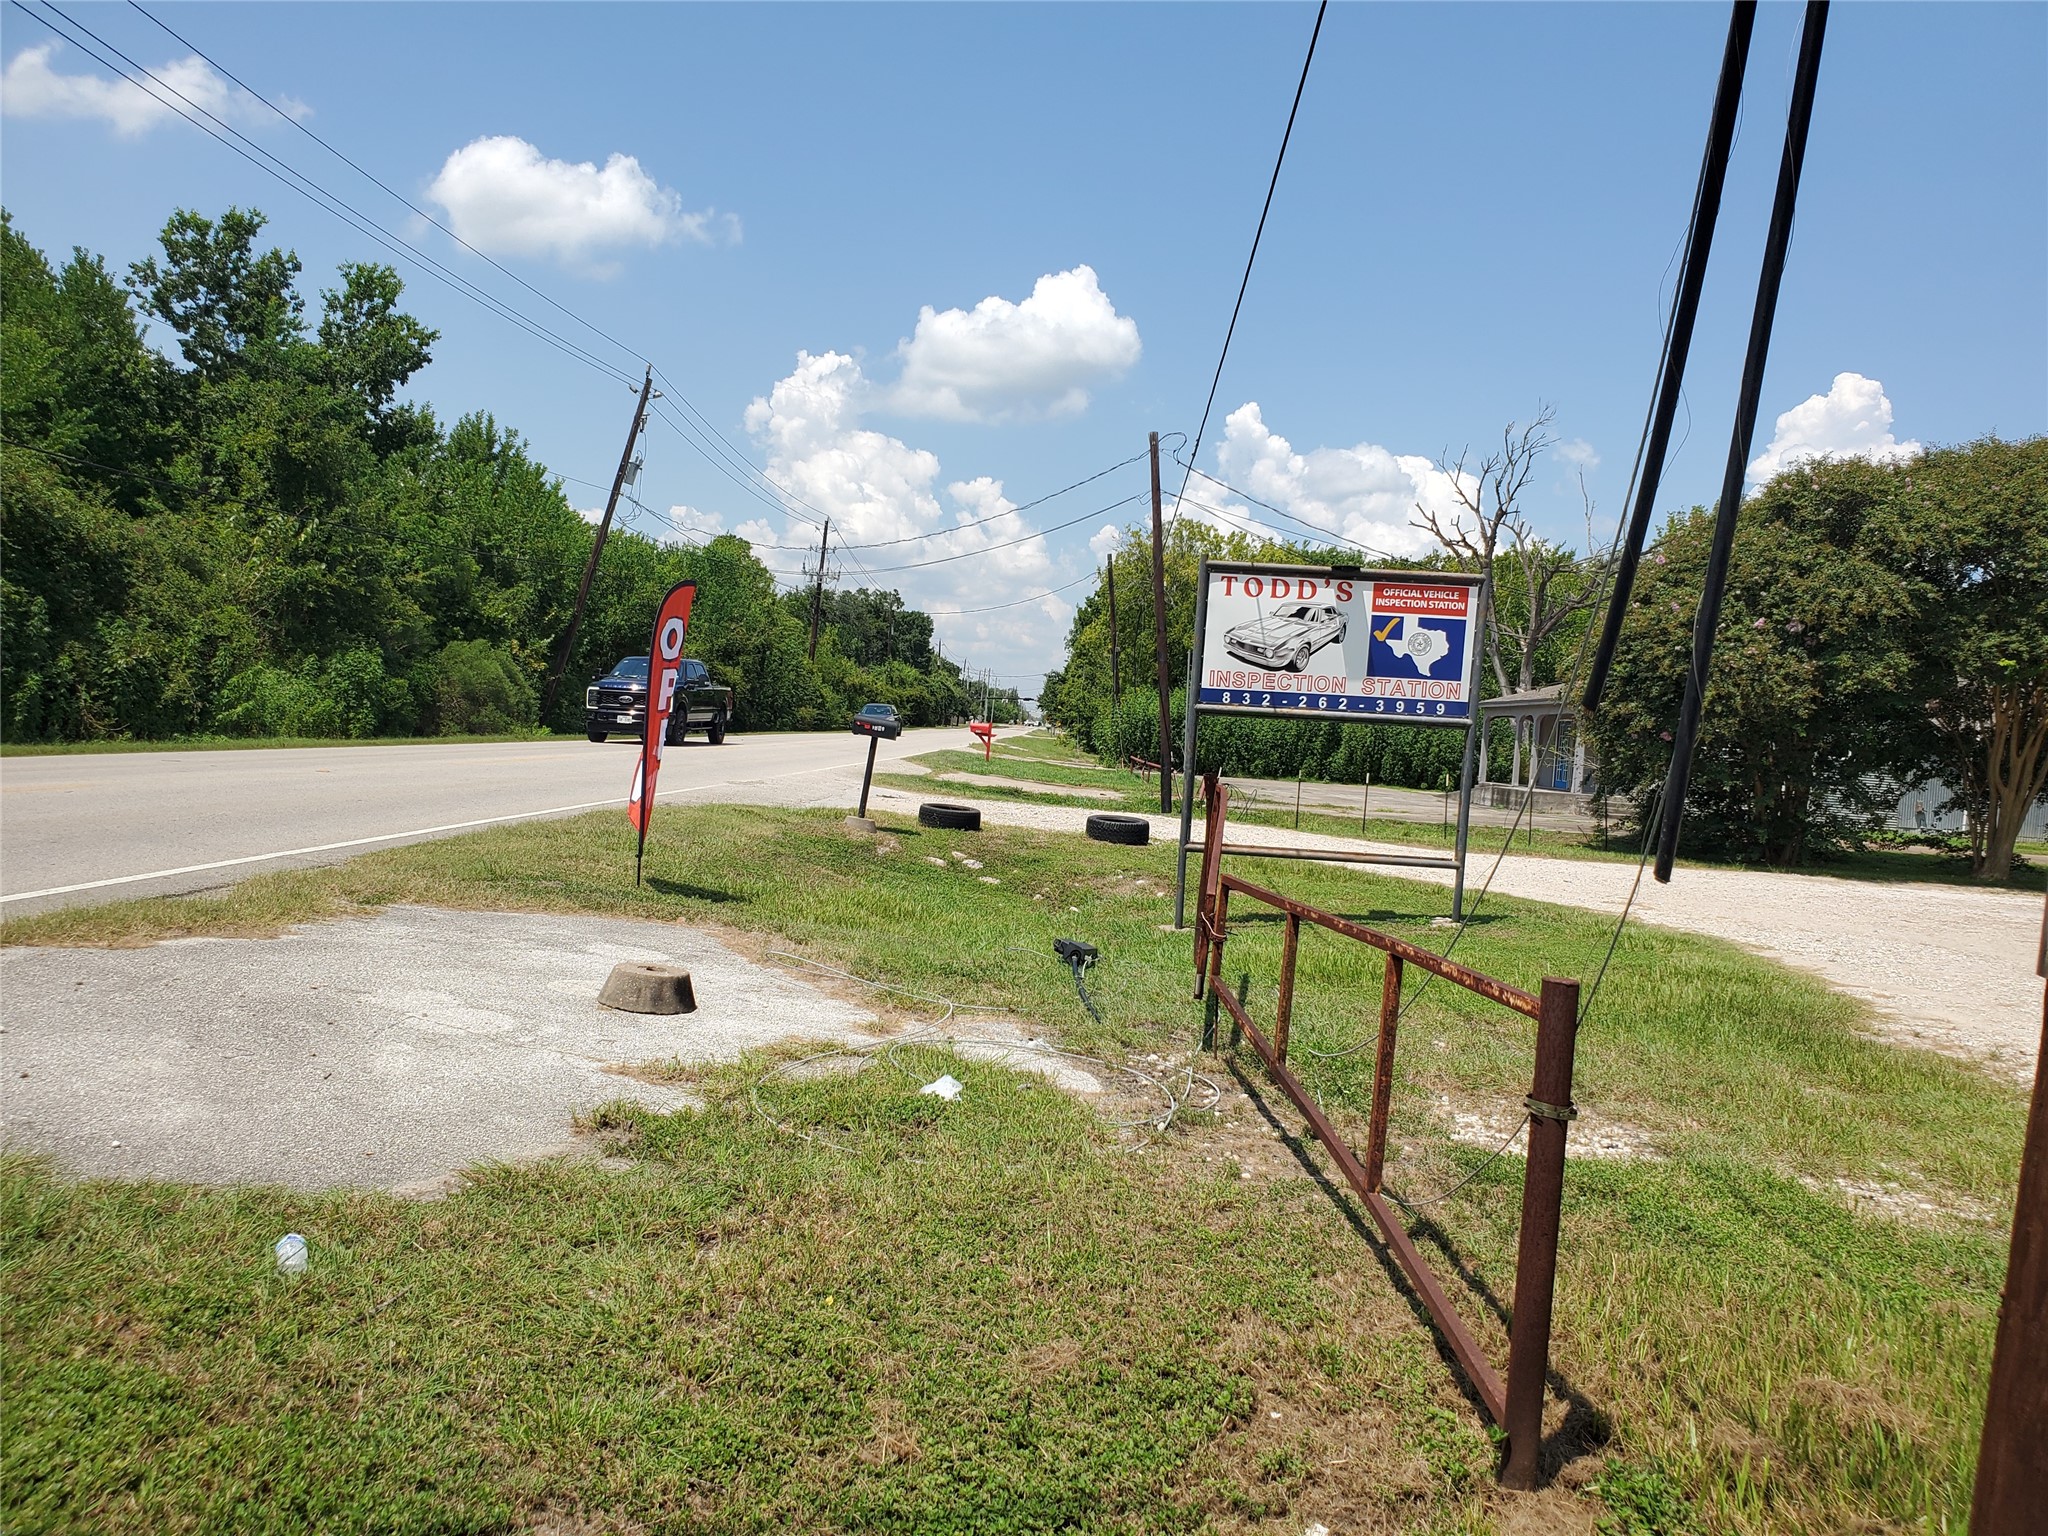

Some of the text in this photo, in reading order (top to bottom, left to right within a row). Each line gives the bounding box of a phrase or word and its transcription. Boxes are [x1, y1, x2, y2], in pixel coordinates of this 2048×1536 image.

[1220, 575, 1354, 602] TODD'S
[1383, 588, 1460, 599] OFFICIAL VEHICLE
[1375, 598, 1465, 610] INSPECTION STATION
[1209, 670, 1462, 700] INSPECTION STATION
